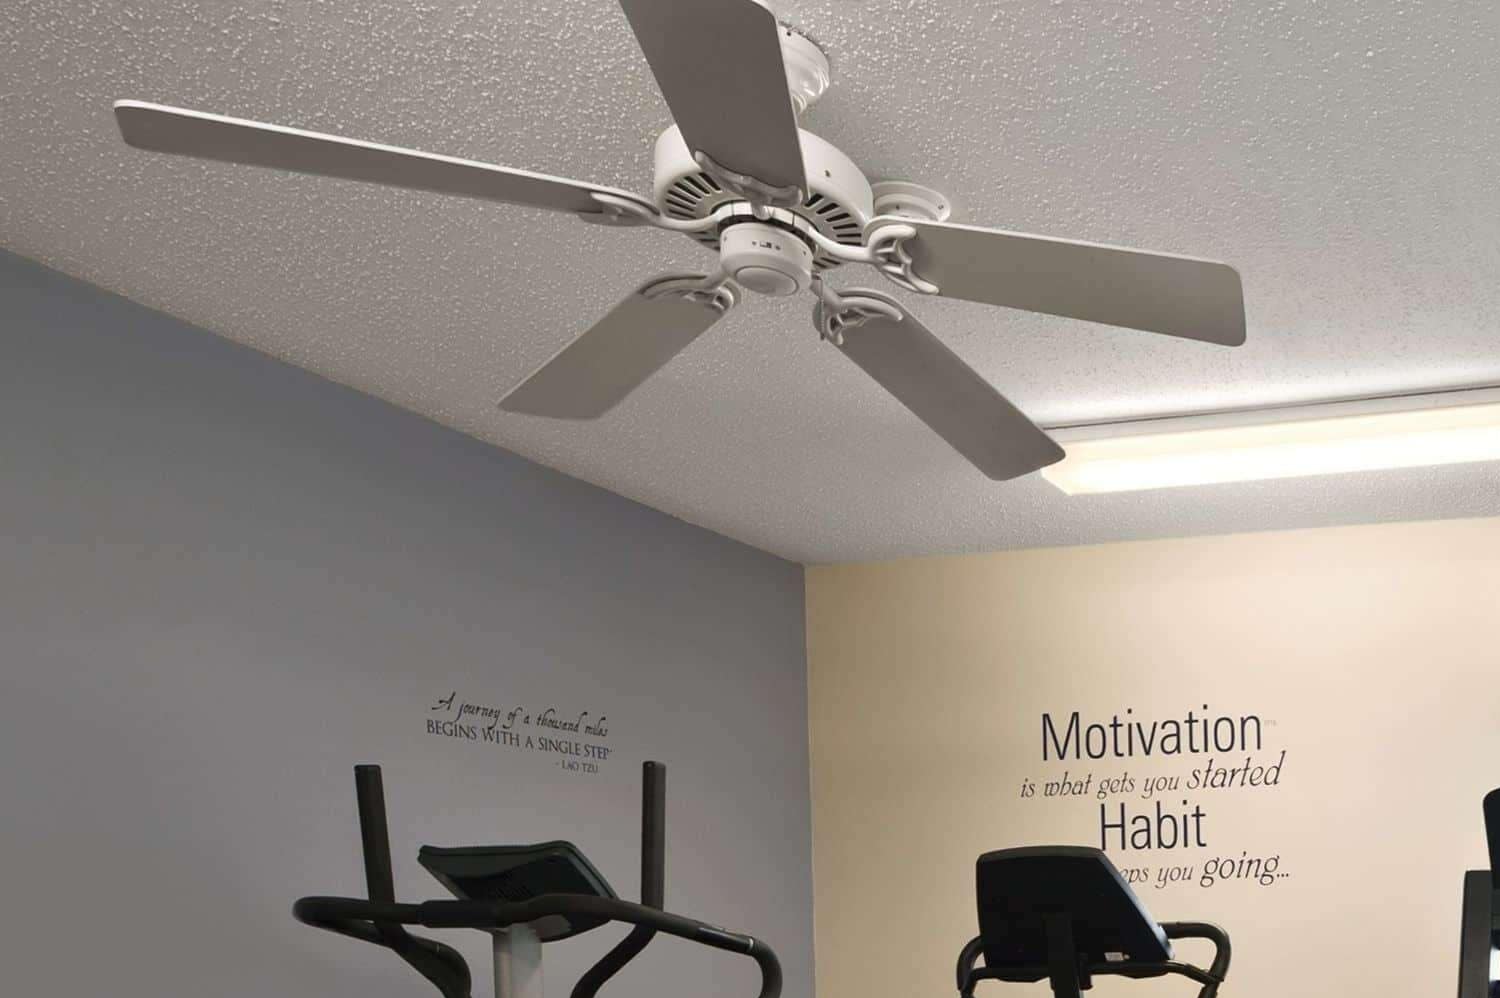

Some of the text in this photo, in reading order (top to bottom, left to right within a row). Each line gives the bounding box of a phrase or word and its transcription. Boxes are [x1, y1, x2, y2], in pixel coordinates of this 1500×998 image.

[431, 691, 456, 711] A
[454, 703, 501, 730] journey
[502, 706, 523, 730] of
[536, 708, 588, 733] thousand
[1041, 703, 1262, 762] Motivation
[426, 719, 478, 741] BEGINS
[481, 727, 520, 748] WITH
[525, 735, 534, 749] A
[538, 736, 582, 756] SINGLE
[1020, 750, 1287, 800] is what gets you started
[1100, 799, 1207, 851] Habit
[1154, 864, 1194, 889] you
